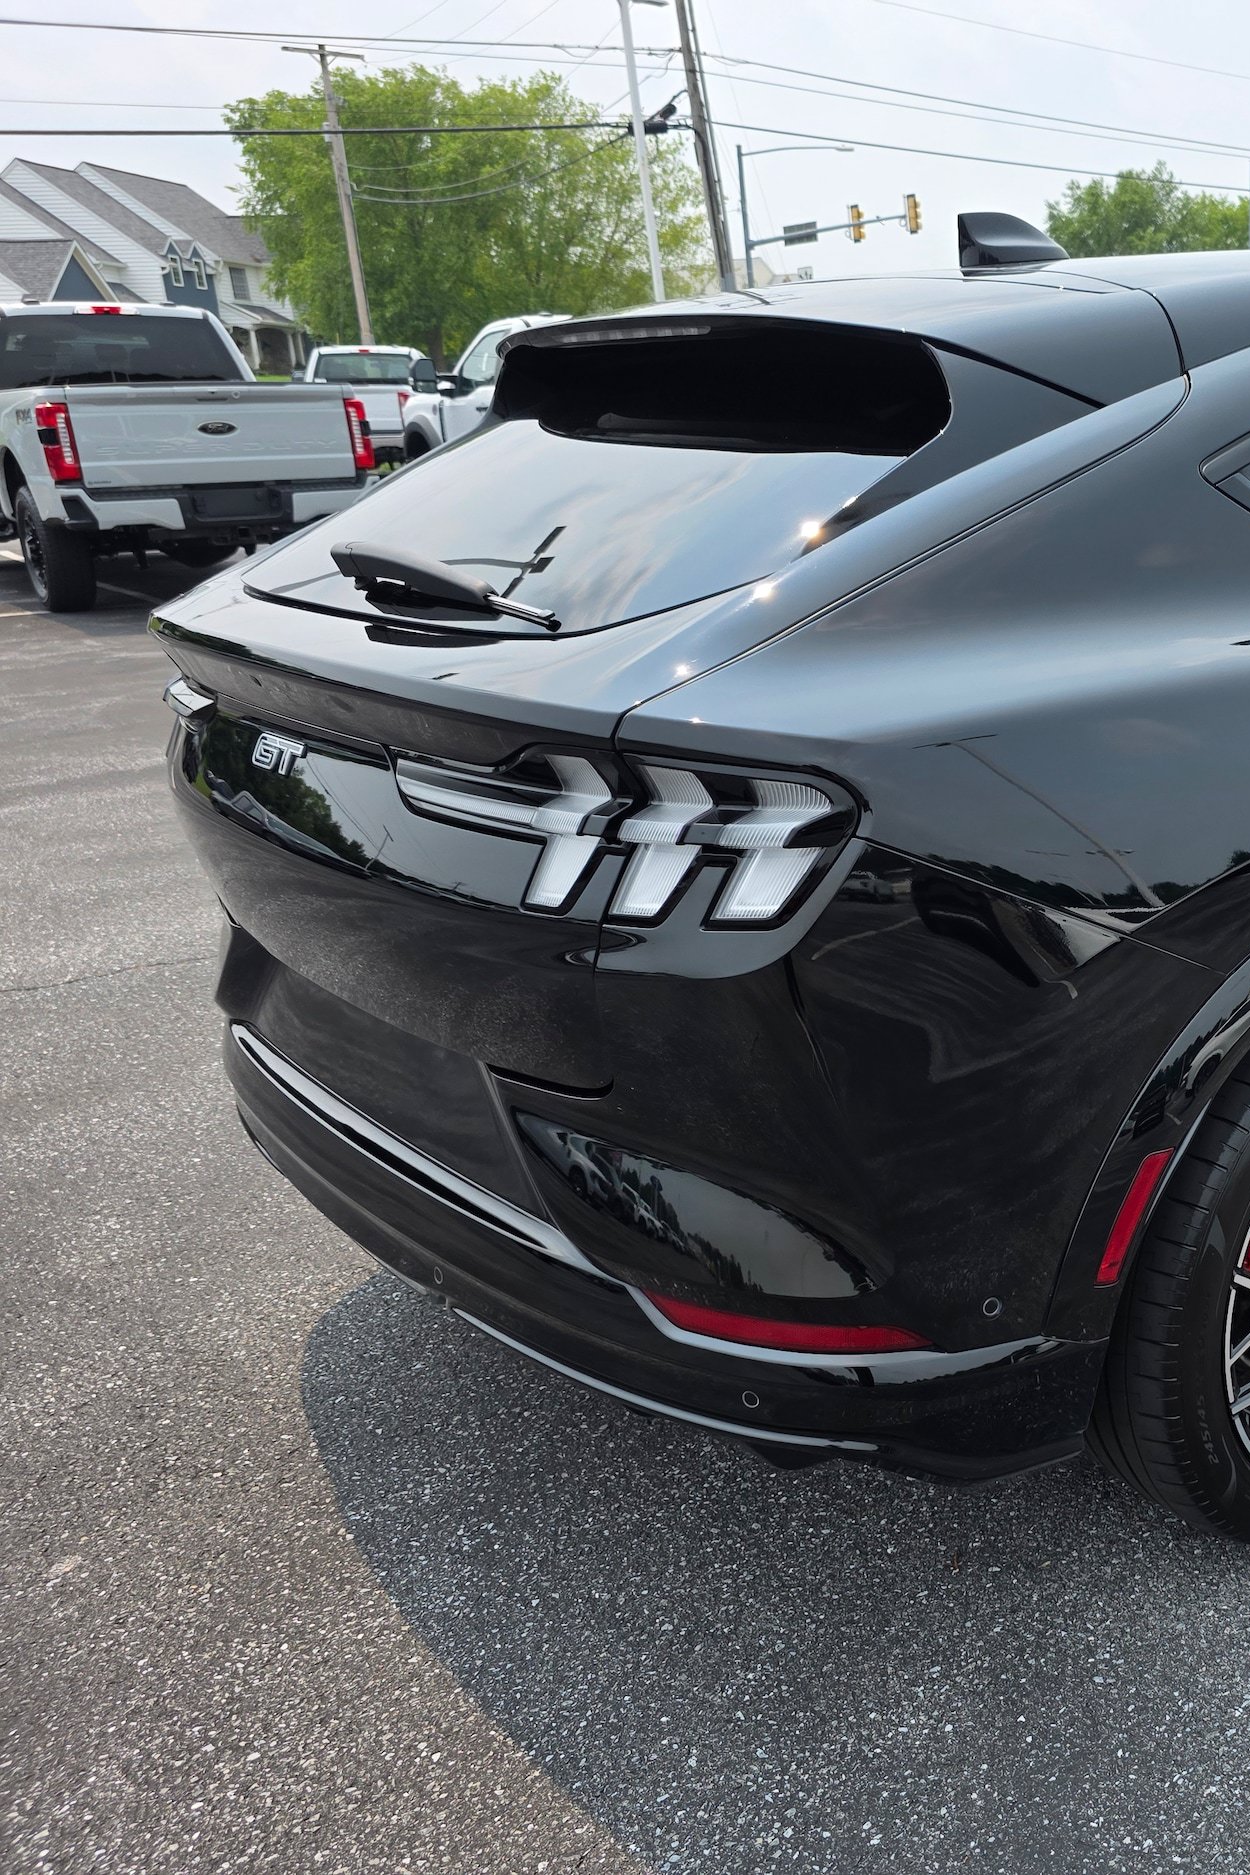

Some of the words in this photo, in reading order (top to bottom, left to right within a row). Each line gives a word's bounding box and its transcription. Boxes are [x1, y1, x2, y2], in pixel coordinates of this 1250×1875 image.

[95, 442, 234, 456] SUPER
[243, 440, 338, 452] DUTY
[252, 731, 306, 775] GT
